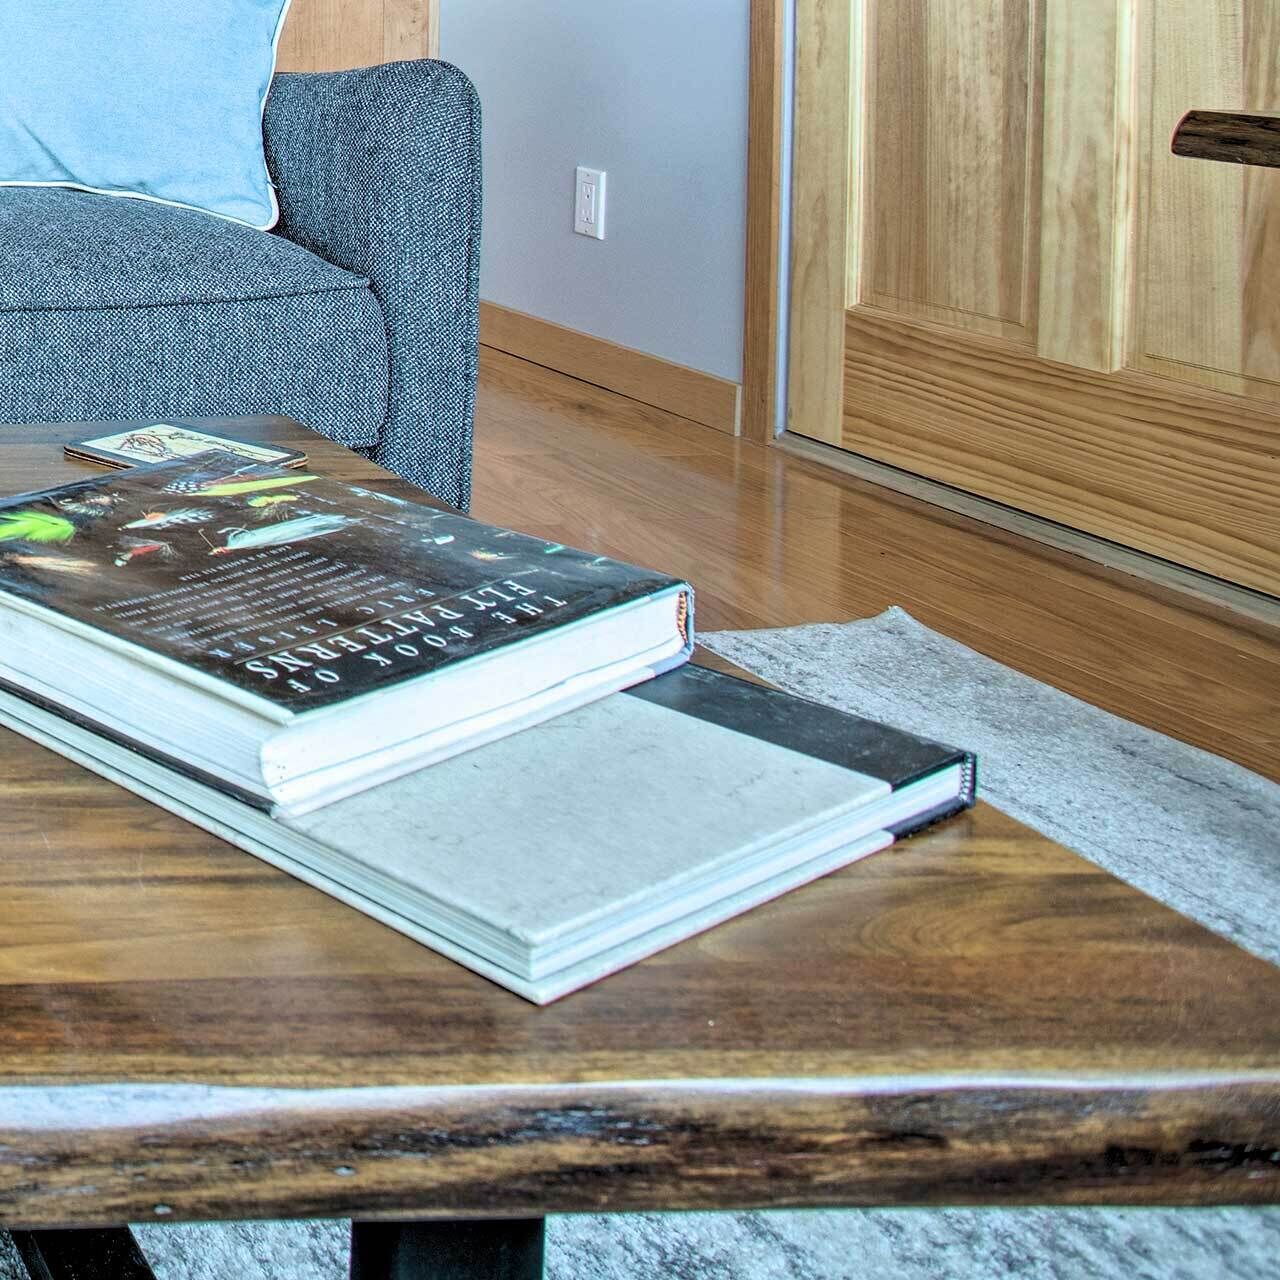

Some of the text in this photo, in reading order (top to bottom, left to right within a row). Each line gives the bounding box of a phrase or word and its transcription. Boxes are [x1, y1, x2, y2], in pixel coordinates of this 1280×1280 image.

[355, 589, 436, 614] ERIC
[459, 579, 538, 609] FLY
[210, 619, 339, 658] LEISER
[245, 606, 466, 679] PATTERNS
[285, 595, 567, 693] THE BOOK OF
